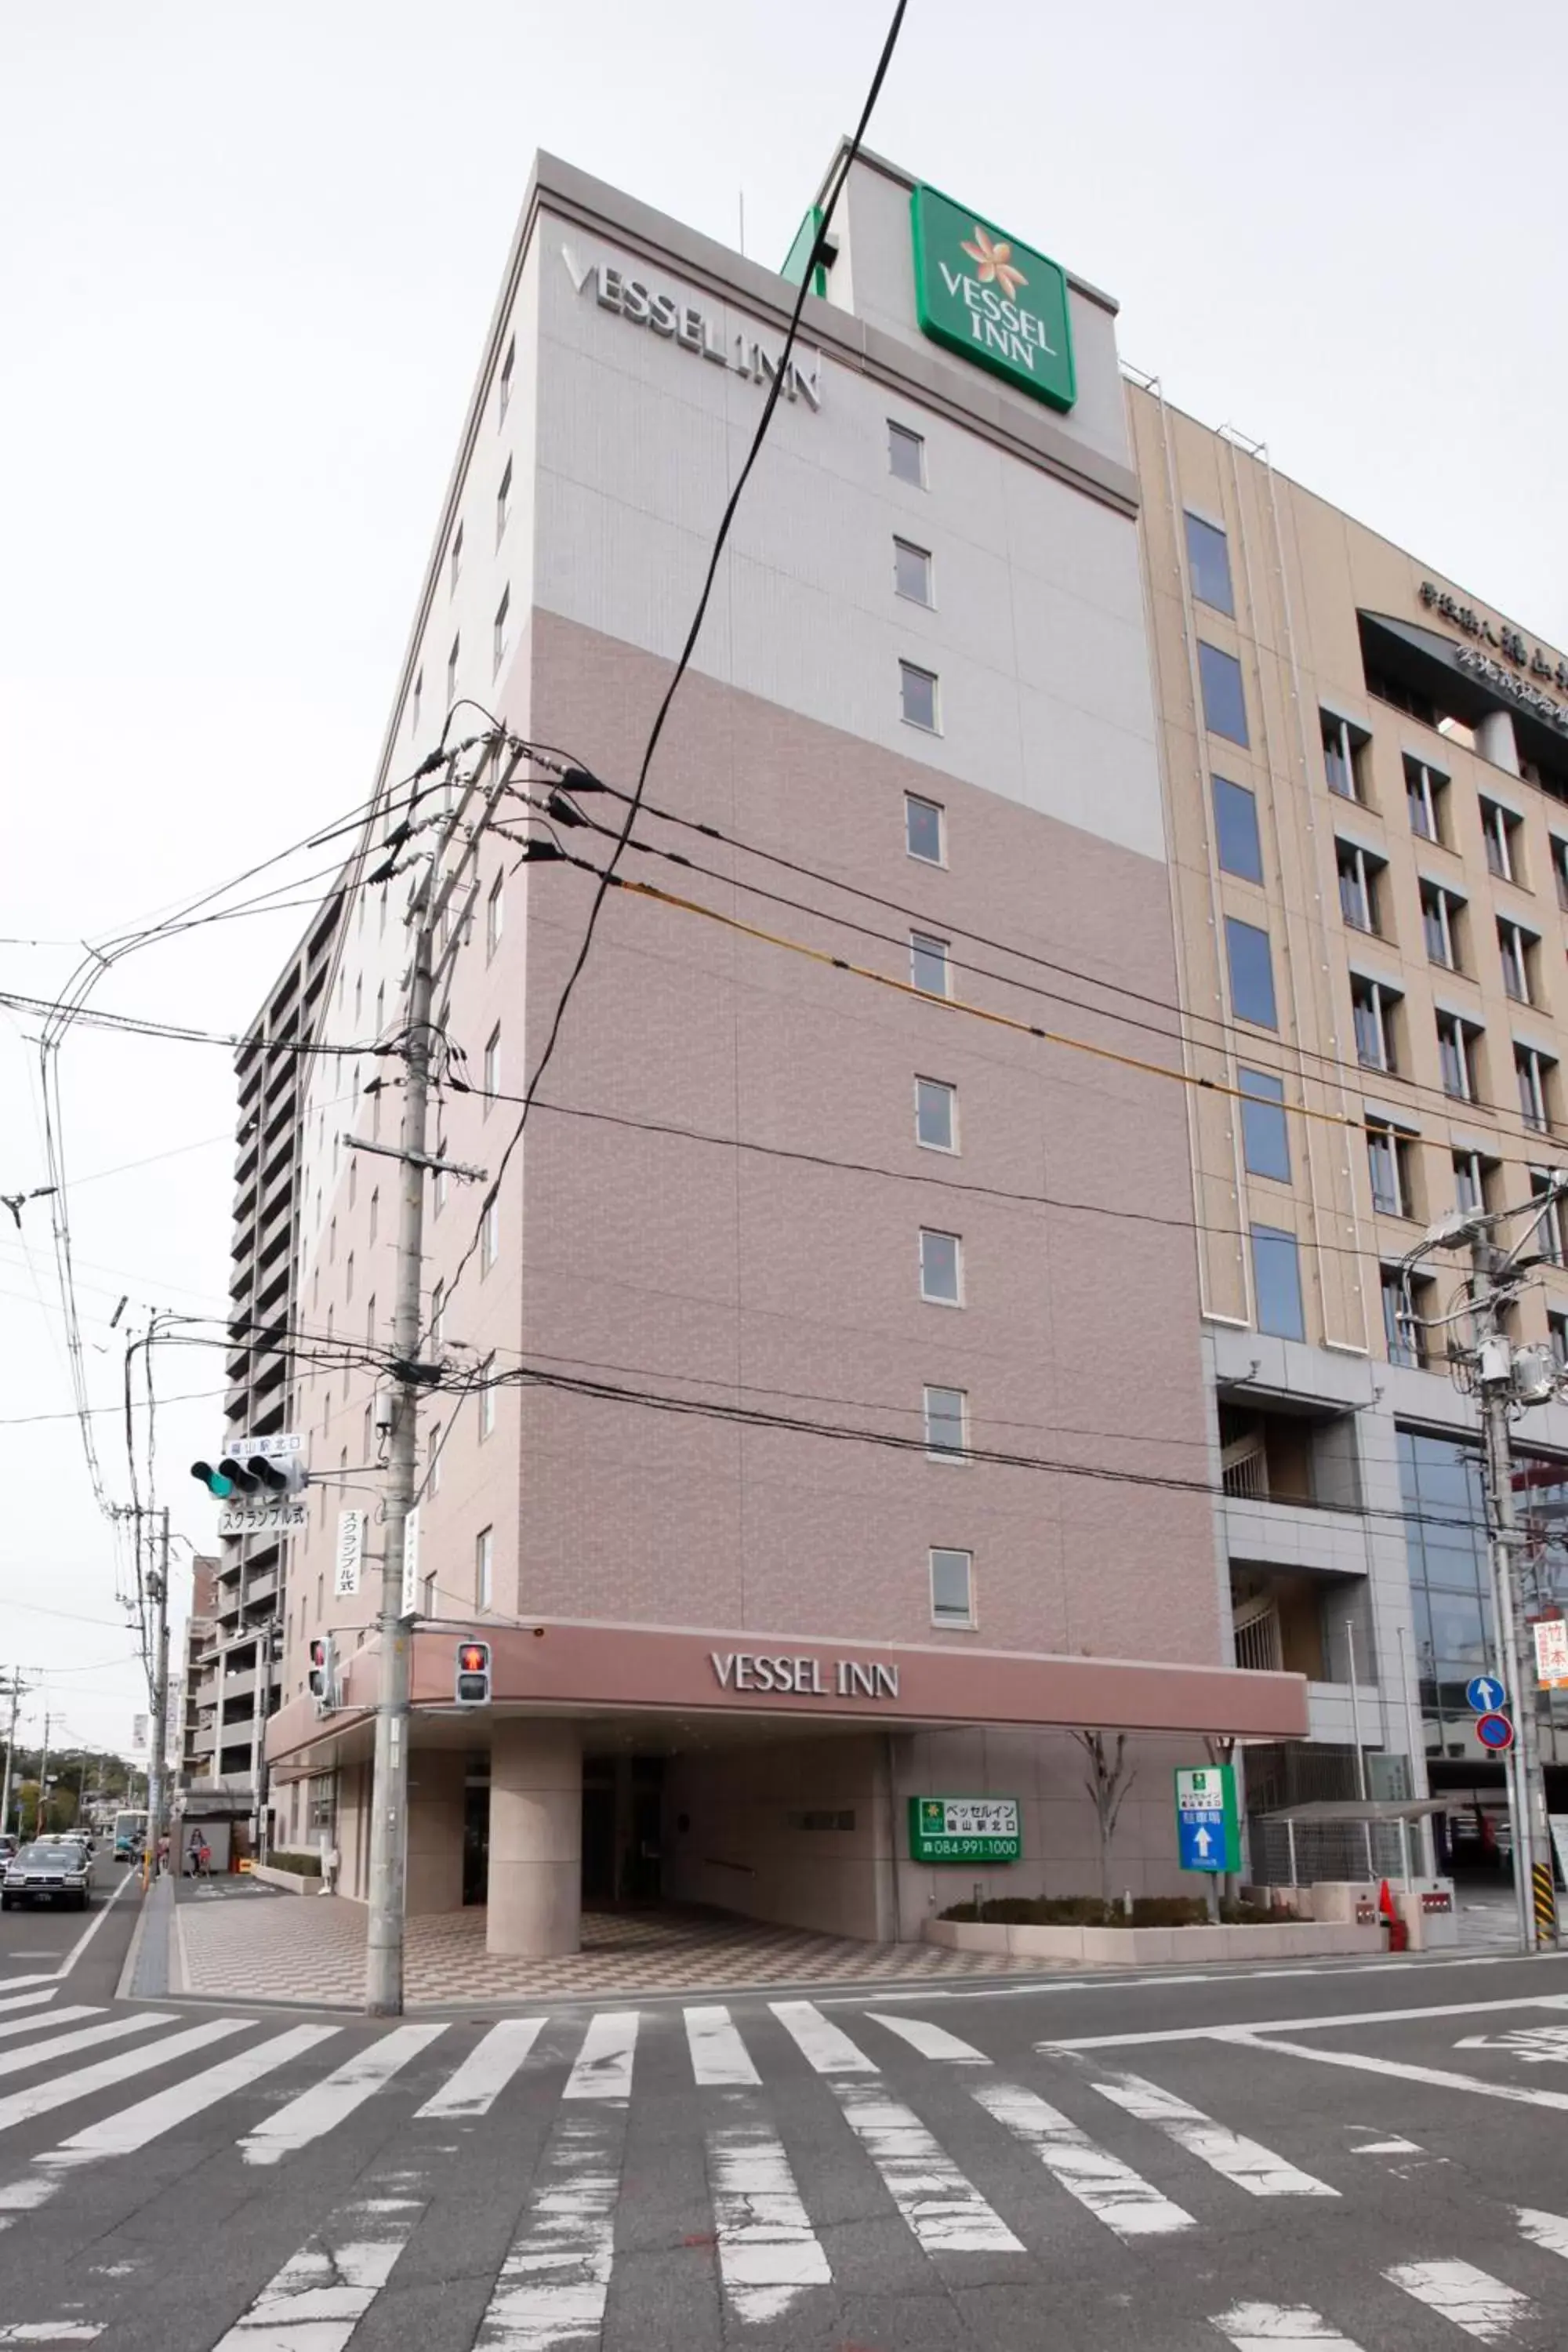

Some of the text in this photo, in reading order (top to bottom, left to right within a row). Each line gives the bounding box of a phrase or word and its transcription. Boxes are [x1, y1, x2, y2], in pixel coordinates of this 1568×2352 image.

[562, 242, 821, 405] VESSEL INN
[938, 261, 1058, 356] VESSEL
[970, 310, 1035, 371] INN
[223, 1506, 304, 1530] スクランブル式
[340, 1512, 358, 1591] スクランブル式
[711, 1652, 899, 1699] VESSEL INN
[946, 1805, 1014, 1818] ベッセルイン
[946, 1820, 1016, 1831] 福山駅北口
[934, 1839, 1018, 1855] 084-991-1000
